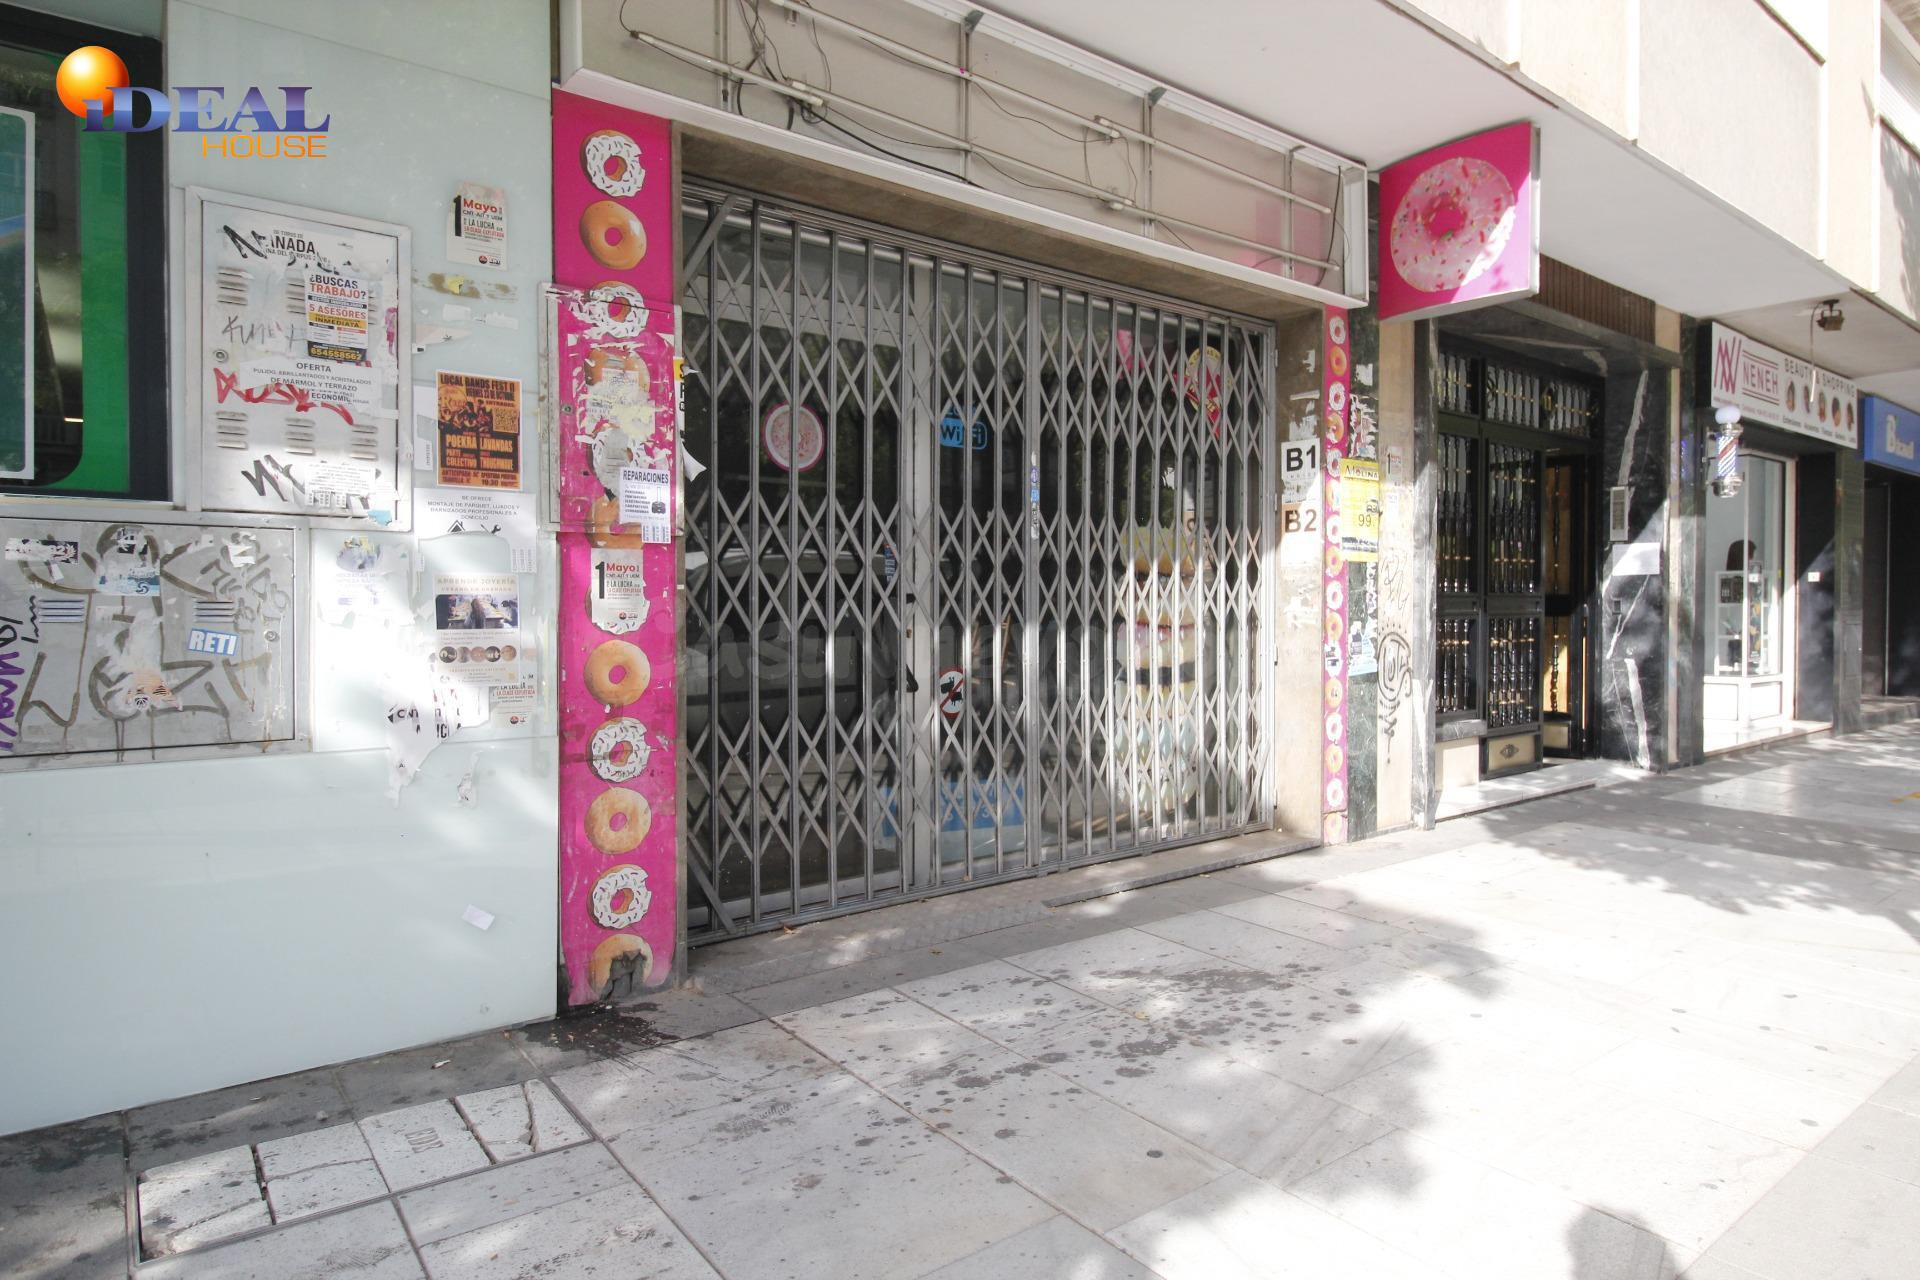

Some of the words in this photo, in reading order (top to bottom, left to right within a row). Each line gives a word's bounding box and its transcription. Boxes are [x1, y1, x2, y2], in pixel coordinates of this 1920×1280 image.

[453, 195, 462, 237] 1
[463, 198, 498, 213] Mayo
[477, 220, 495, 230] LUCHA
[310, 274, 358, 290] ¿BUSCAS
[310, 283, 367, 300] TRABAJO?
[310, 304, 316, 312] 5
[318, 305, 367, 319] ASESORES
[296, 361, 332, 373] OFERTA
[440, 373, 464, 387] LOCAL
[465, 376, 491, 389] BANDS
[492, 379, 508, 391] FEST
[1743, 361, 1779, 396] NENEH
[325, 382, 358, 392] TERRAZO
[1286, 445, 1317, 472] B1
[623, 470, 669, 484] REPARACIONES
[1344, 464, 1379, 479] MOLINA
[1285, 509, 1318, 533] B2
[595, 561, 605, 599] 1
[606, 563, 636, 574] Mayo
[610, 580, 617, 588] LA
[617, 580, 634, 588] LUCHA
[189, 629, 238, 656] RETI
